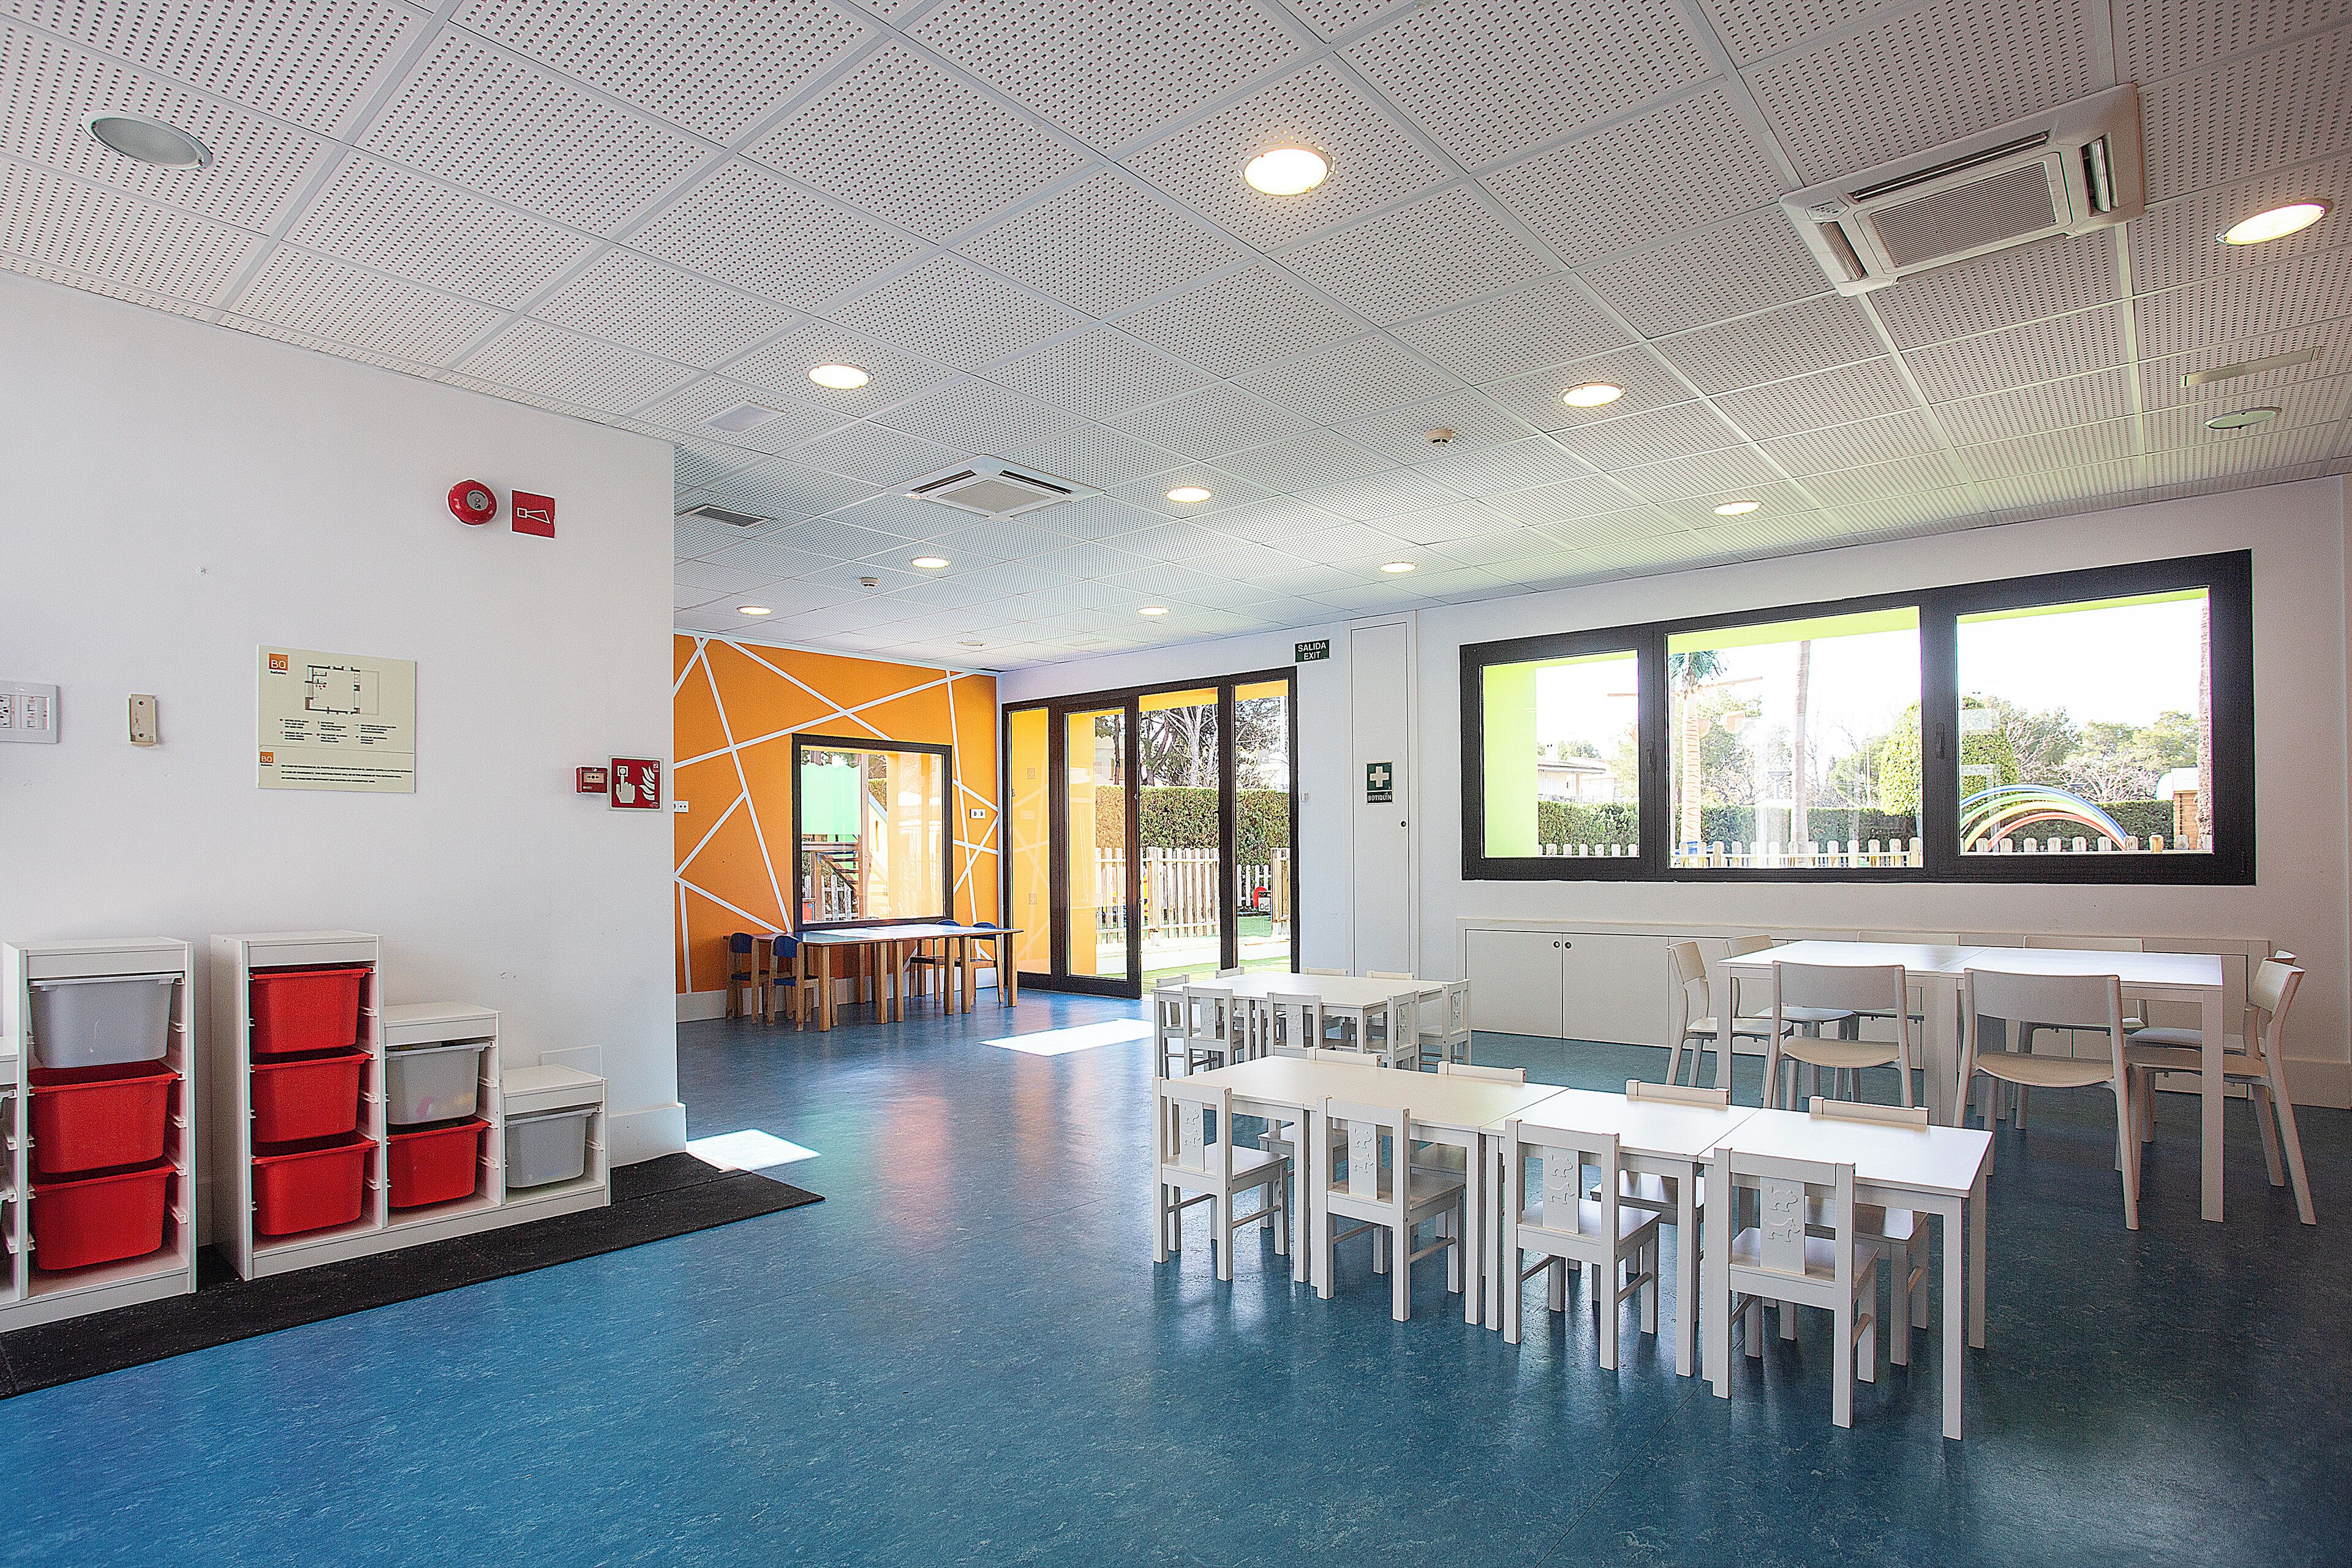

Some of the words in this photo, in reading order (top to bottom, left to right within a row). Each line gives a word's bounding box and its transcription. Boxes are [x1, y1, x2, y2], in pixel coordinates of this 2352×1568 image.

[1298, 642, 1327, 652] SALIDA
[1303, 651, 1321, 660] EXIT
[271, 659, 287, 669] BQ
